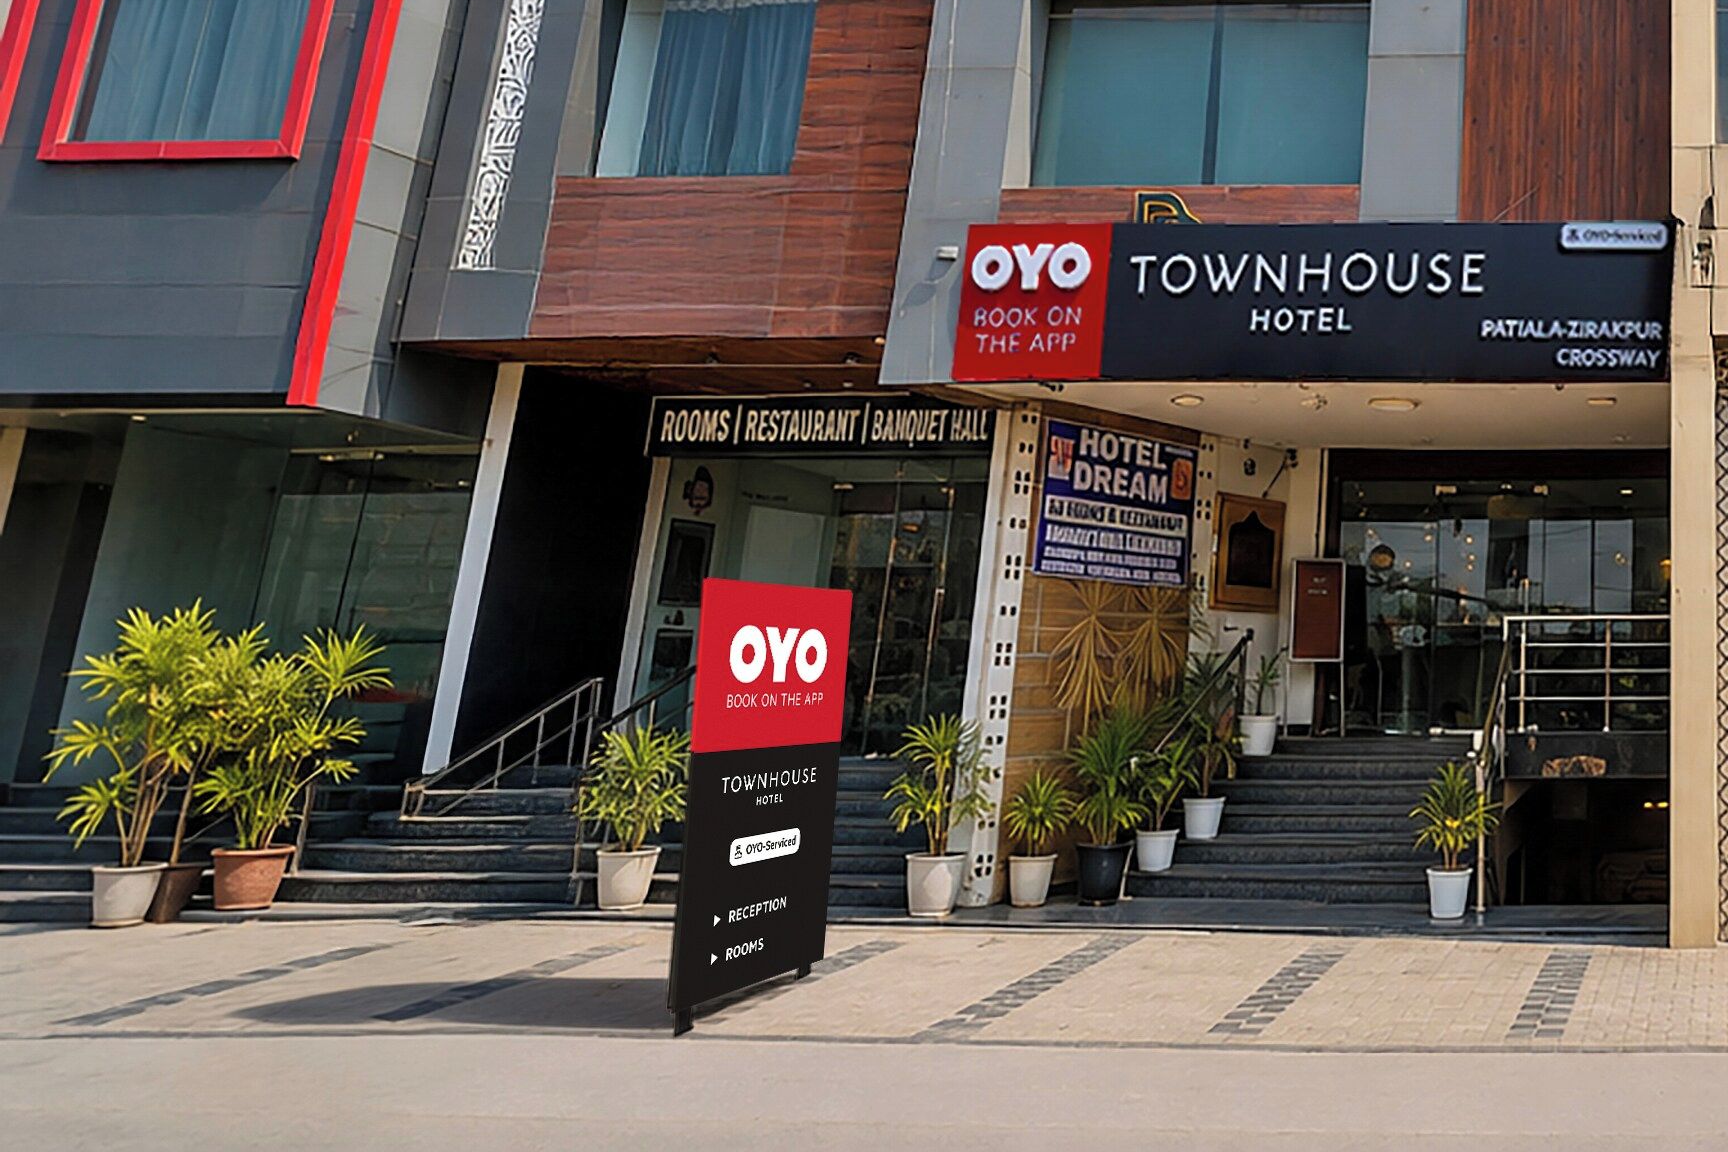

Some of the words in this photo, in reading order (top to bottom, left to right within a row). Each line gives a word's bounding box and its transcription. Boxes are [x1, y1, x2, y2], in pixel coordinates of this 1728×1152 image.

[970, 242, 1092, 290] OYO
[1130, 252, 1487, 294] TOWNHOUSE
[973, 307, 1039, 328] BOOK
[1047, 305, 1082, 326] ON
[1249, 307, 1351, 332] HOTEL
[1480, 319, 1663, 340] PATIALA-ZIRAKPUR
[975, 333, 1020, 353] THE
[1028, 332, 1077, 353] APP
[1556, 348, 1661, 368] CROSSWAY
[660, 409, 732, 442] ROOMS
[744, 409, 861, 442] RESTAURANT
[870, 409, 949, 448] BANQUET
[949, 409, 991, 441] HALL
[1079, 428, 1168, 470] HOTEL
[1073, 460, 1169, 504] DREAM
[729, 624, 828, 684] OYO
[726, 693, 758, 709] BOOK
[760, 693, 778, 708] ON
[780, 693, 802, 707] THE
[804, 692, 824, 706] APP
[721, 766, 817, 794] TOWNHOUSE
[755, 793, 784, 806] HOTEL
[745, 834, 797, 855] OYO-Serviced
[728, 896, 788, 924] RECEPTION
[725, 937, 764, 962] ROOMS
